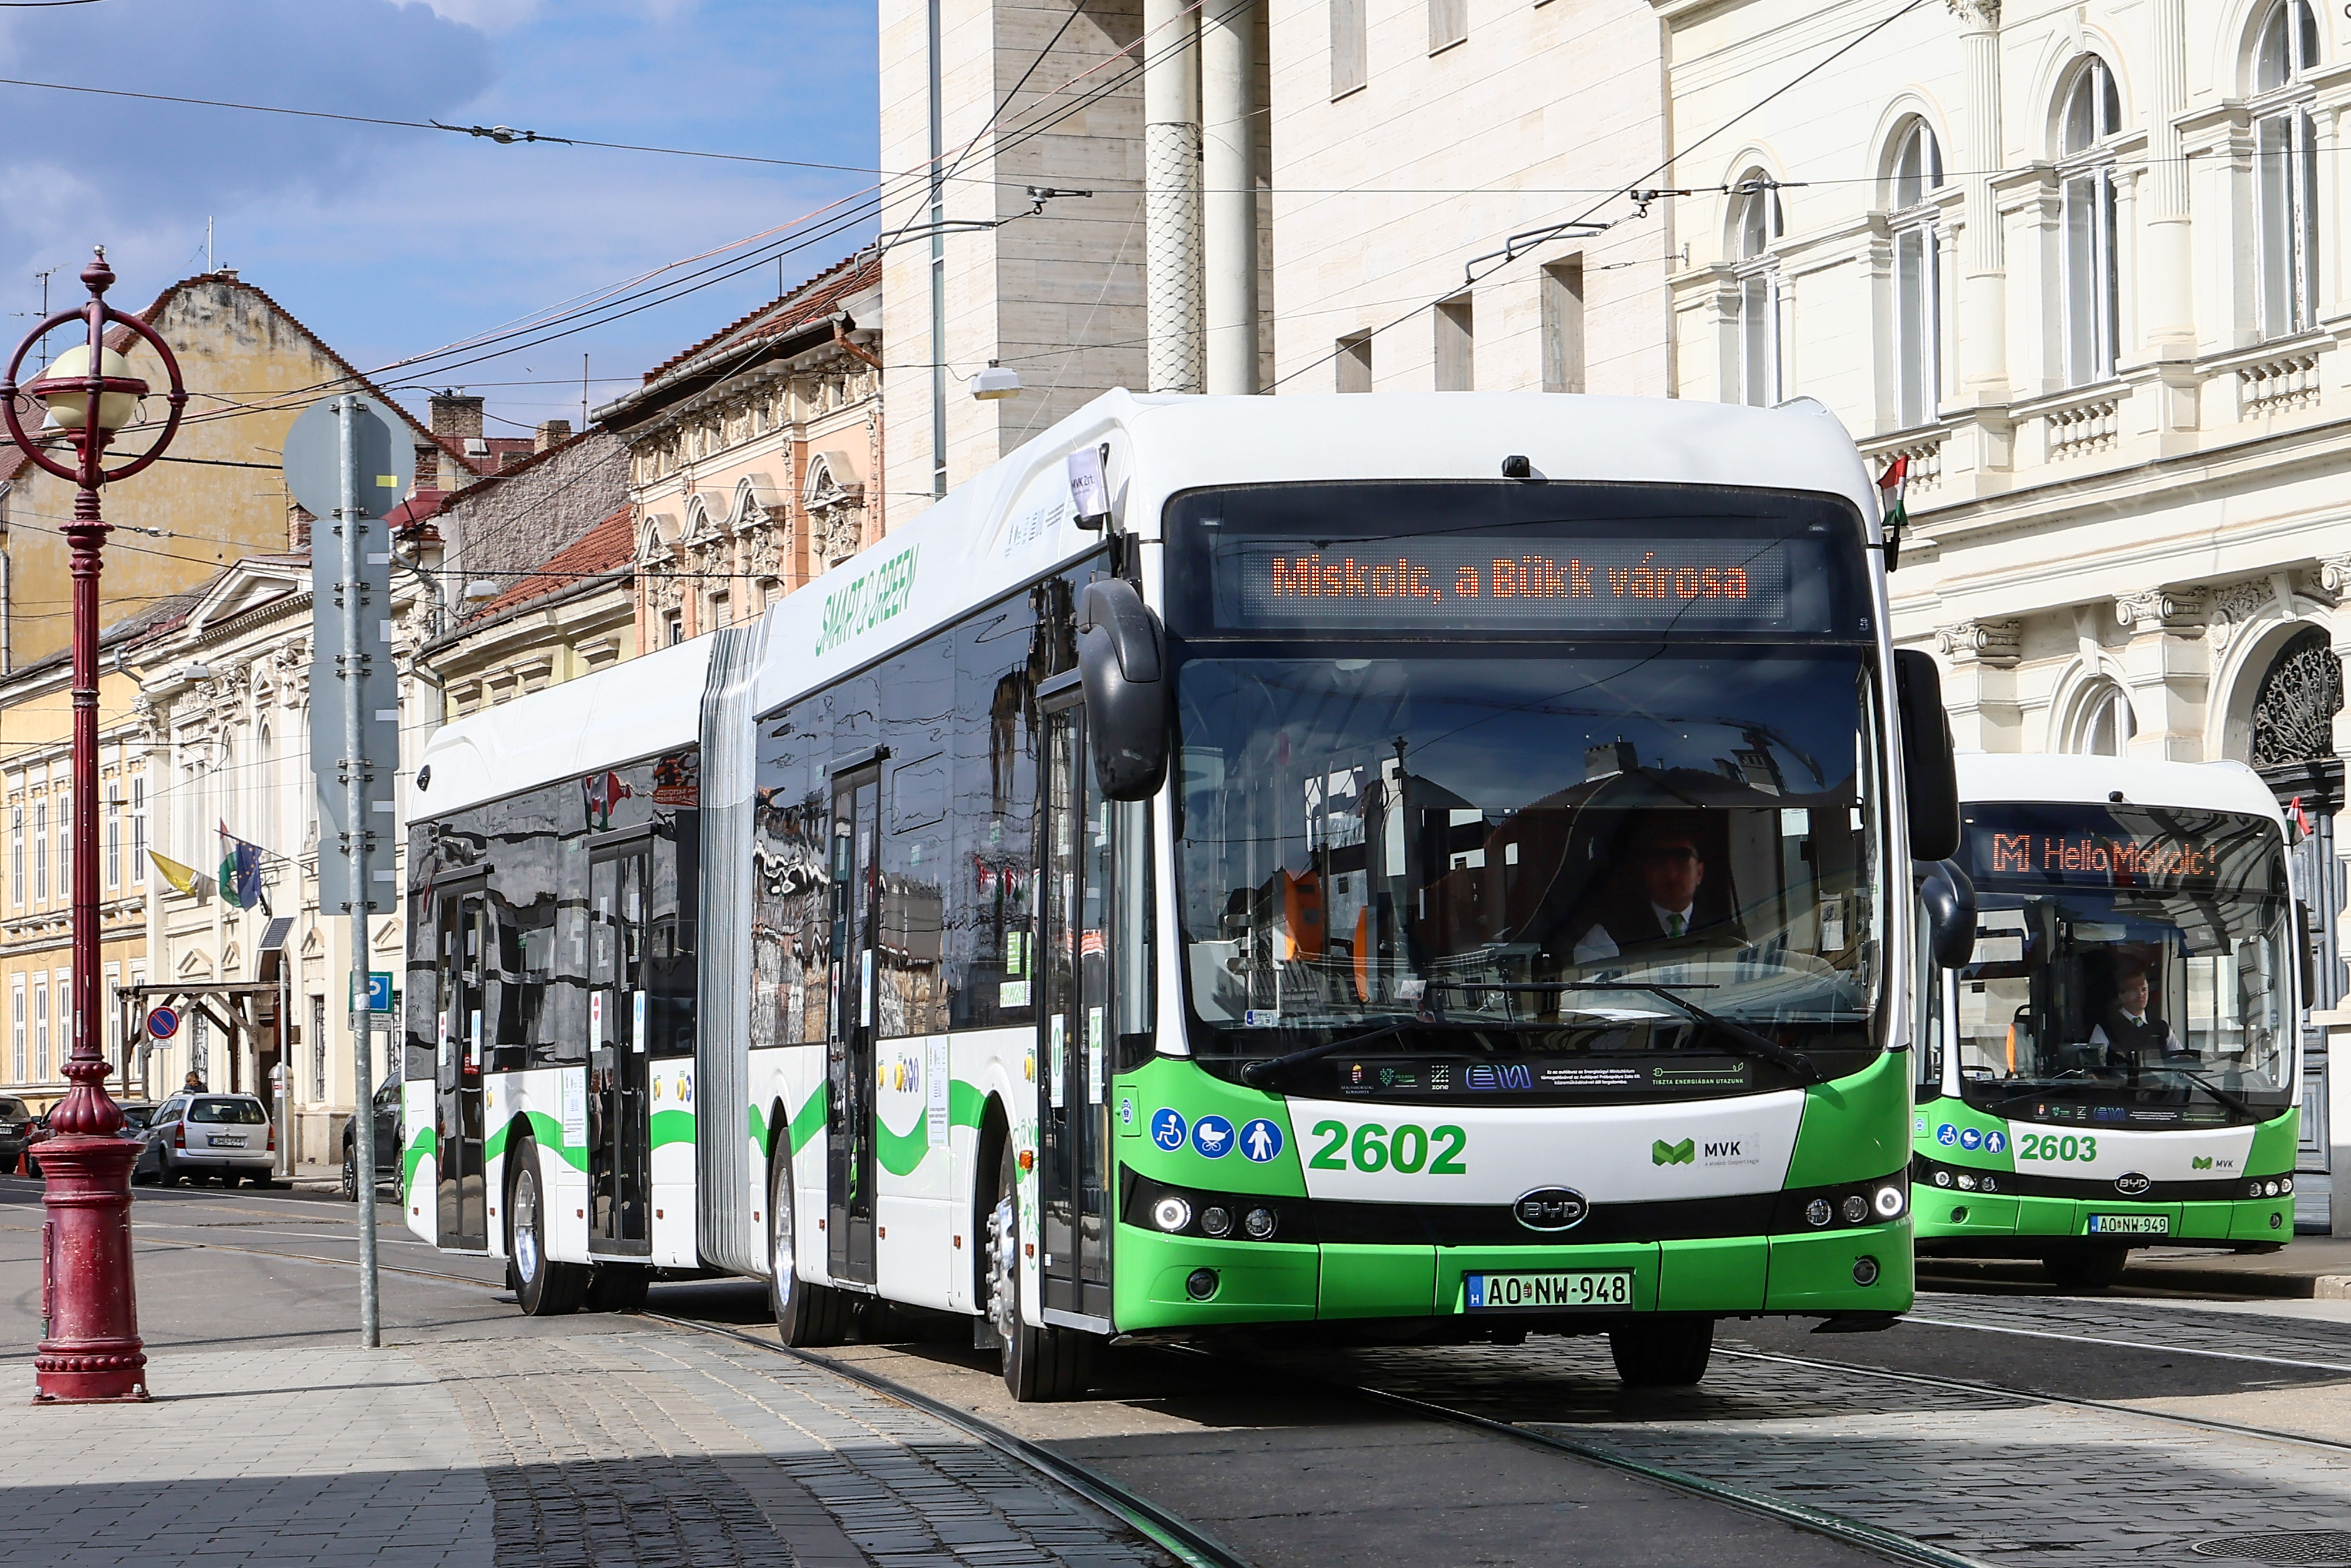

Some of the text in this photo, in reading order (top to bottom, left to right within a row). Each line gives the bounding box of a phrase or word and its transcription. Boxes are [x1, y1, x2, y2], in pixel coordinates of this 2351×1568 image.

[1273, 551, 1747, 605] Miskolc, a Bükk városa
[815, 576, 865, 657] SMART
[868, 543, 919, 628] GREEN
[2044, 838, 2108, 871] Hello
[1308, 1119, 1467, 1175] 2602
[1705, 1141, 1741, 1157] MVK
[2019, 1134, 2097, 1162] 2603
[2119, 1179, 2148, 1188] BYD
[1523, 1202, 1581, 1218] BYD
[2100, 1218, 2116, 1232] AO
[2122, 1218, 2166, 1232] NW-949
[1471, 1276, 1626, 1305] H AO NW-948
